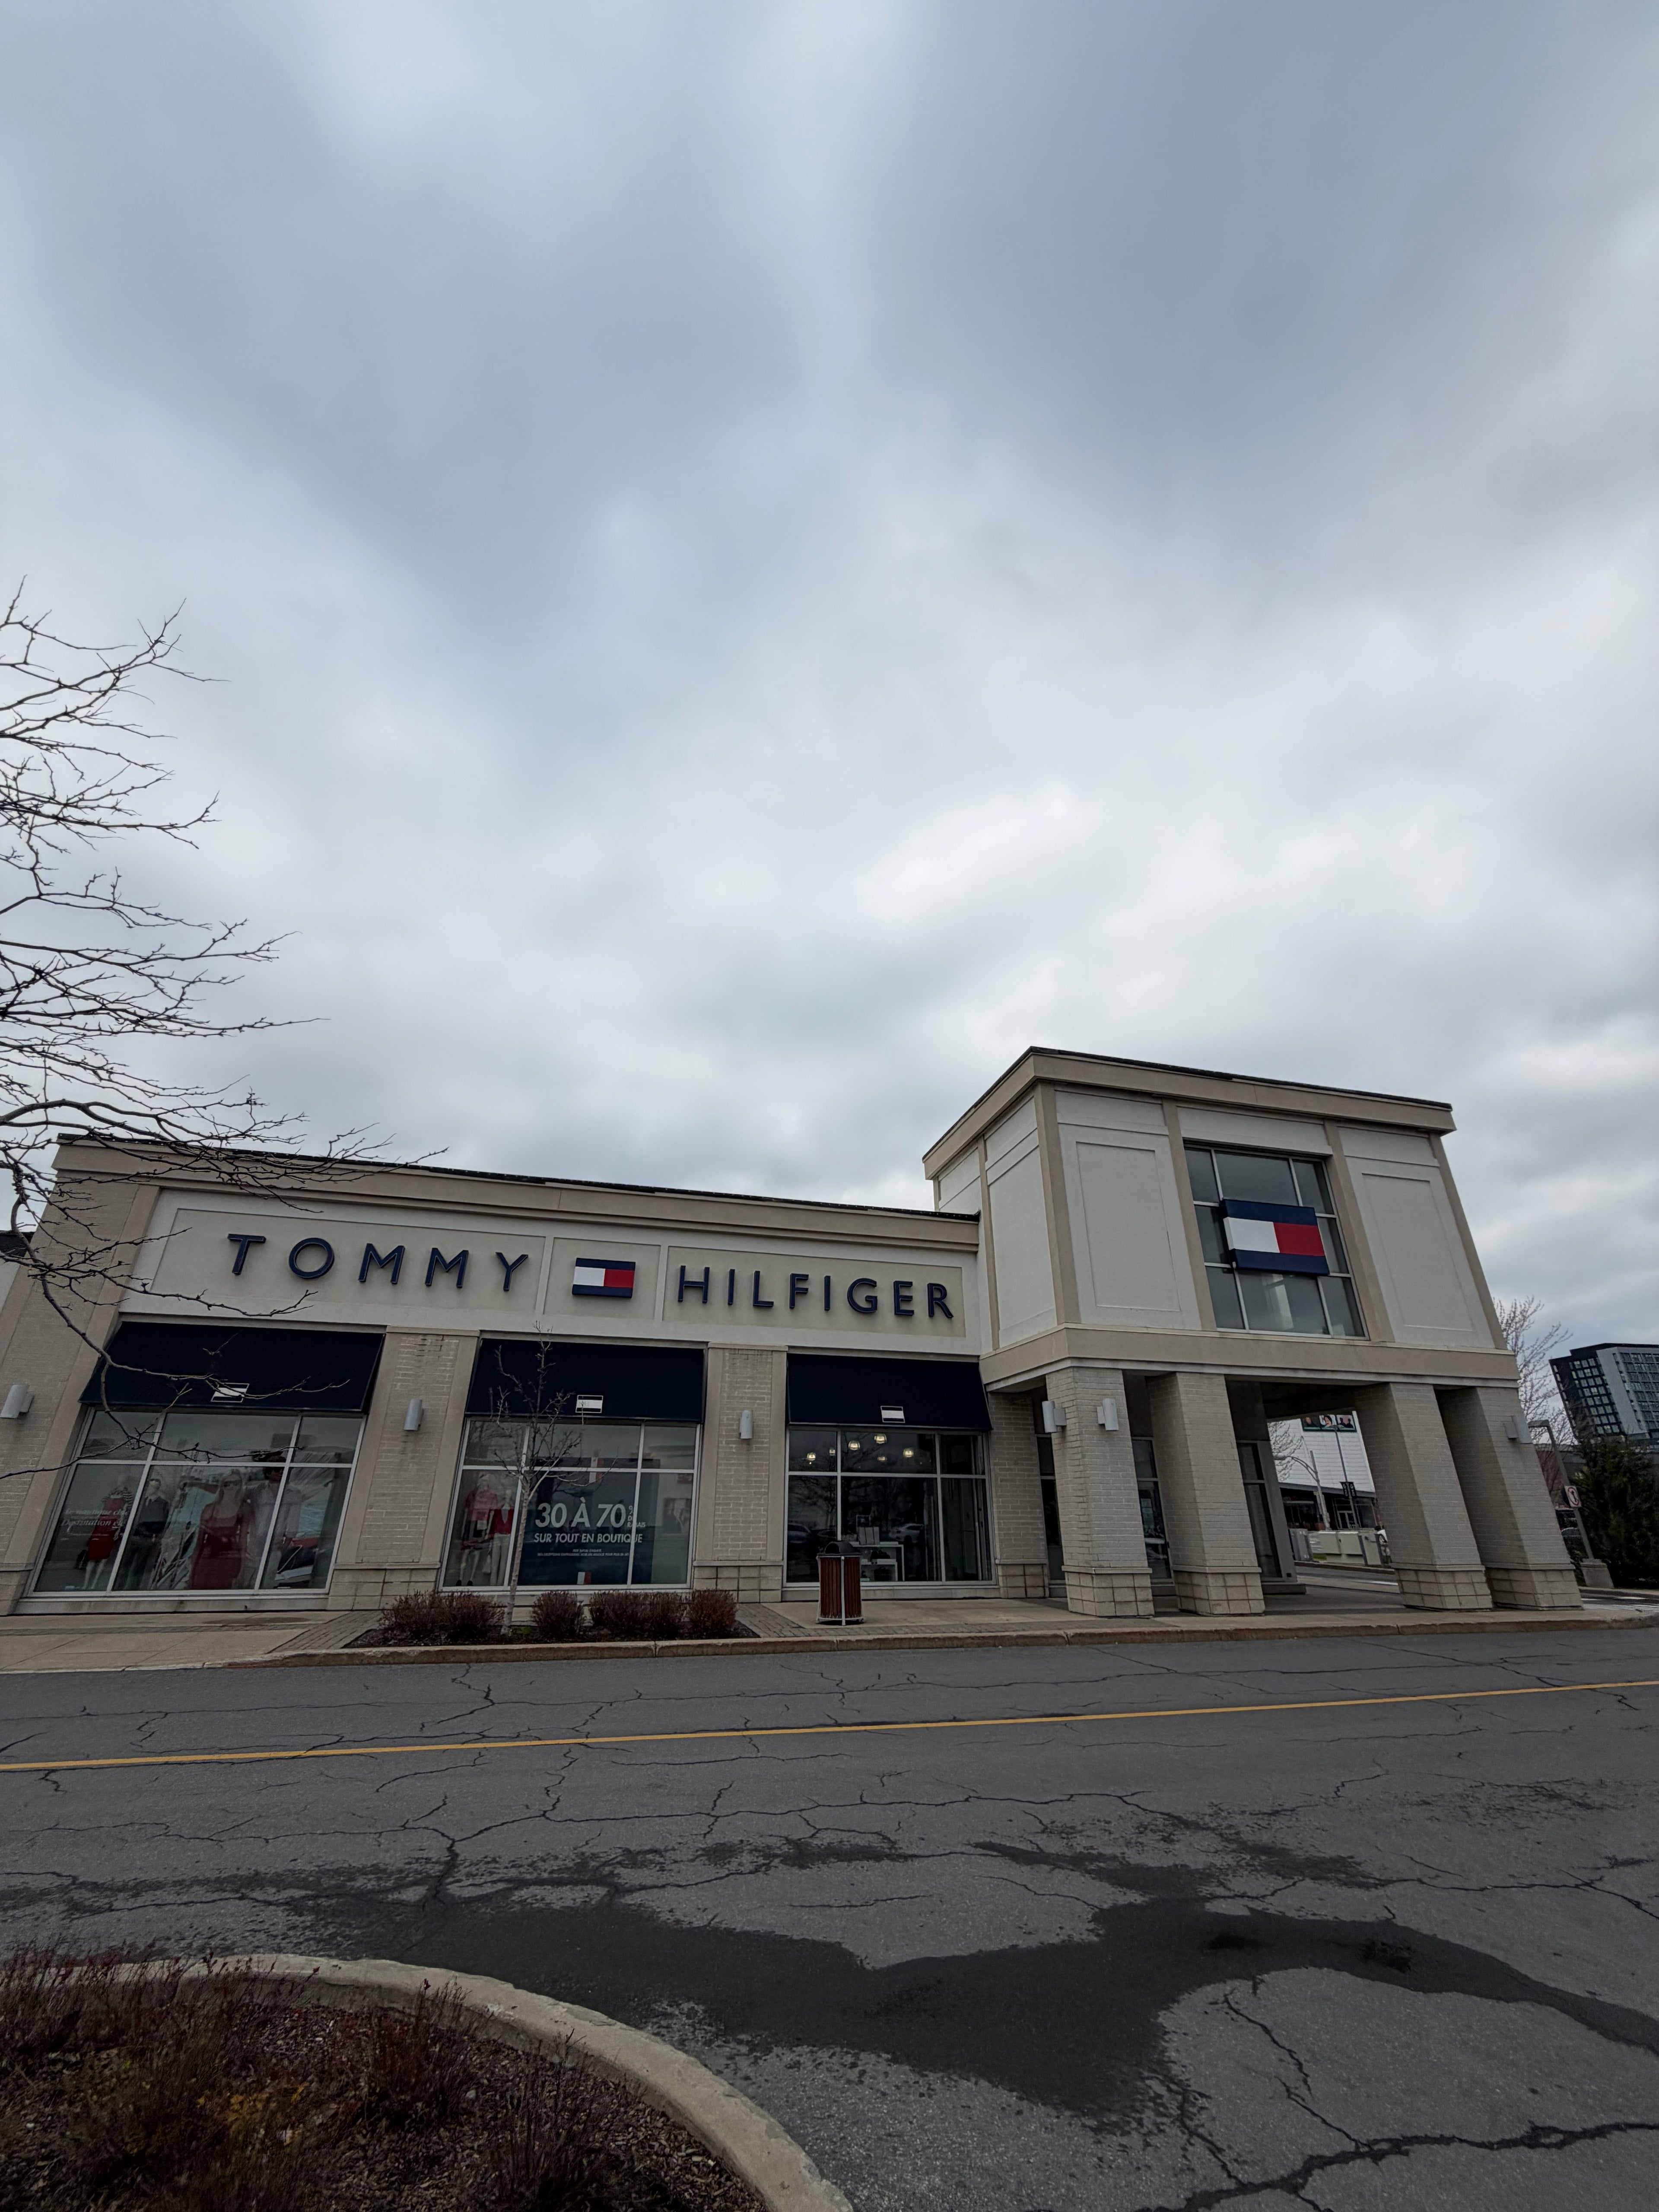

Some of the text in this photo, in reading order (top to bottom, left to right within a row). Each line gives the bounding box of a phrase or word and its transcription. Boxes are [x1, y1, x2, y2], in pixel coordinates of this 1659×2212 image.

[227, 1233, 954, 1319] TOMMY HILFIGER
[535, 1503, 567, 1528] 30
[571, 1497, 591, 1528] À
[596, 1503, 626, 1528] 70
[534, 1533, 552, 1543] SUR
[555, 1534, 579, 1543] TOUT
[581, 1534, 594, 1543] EN
